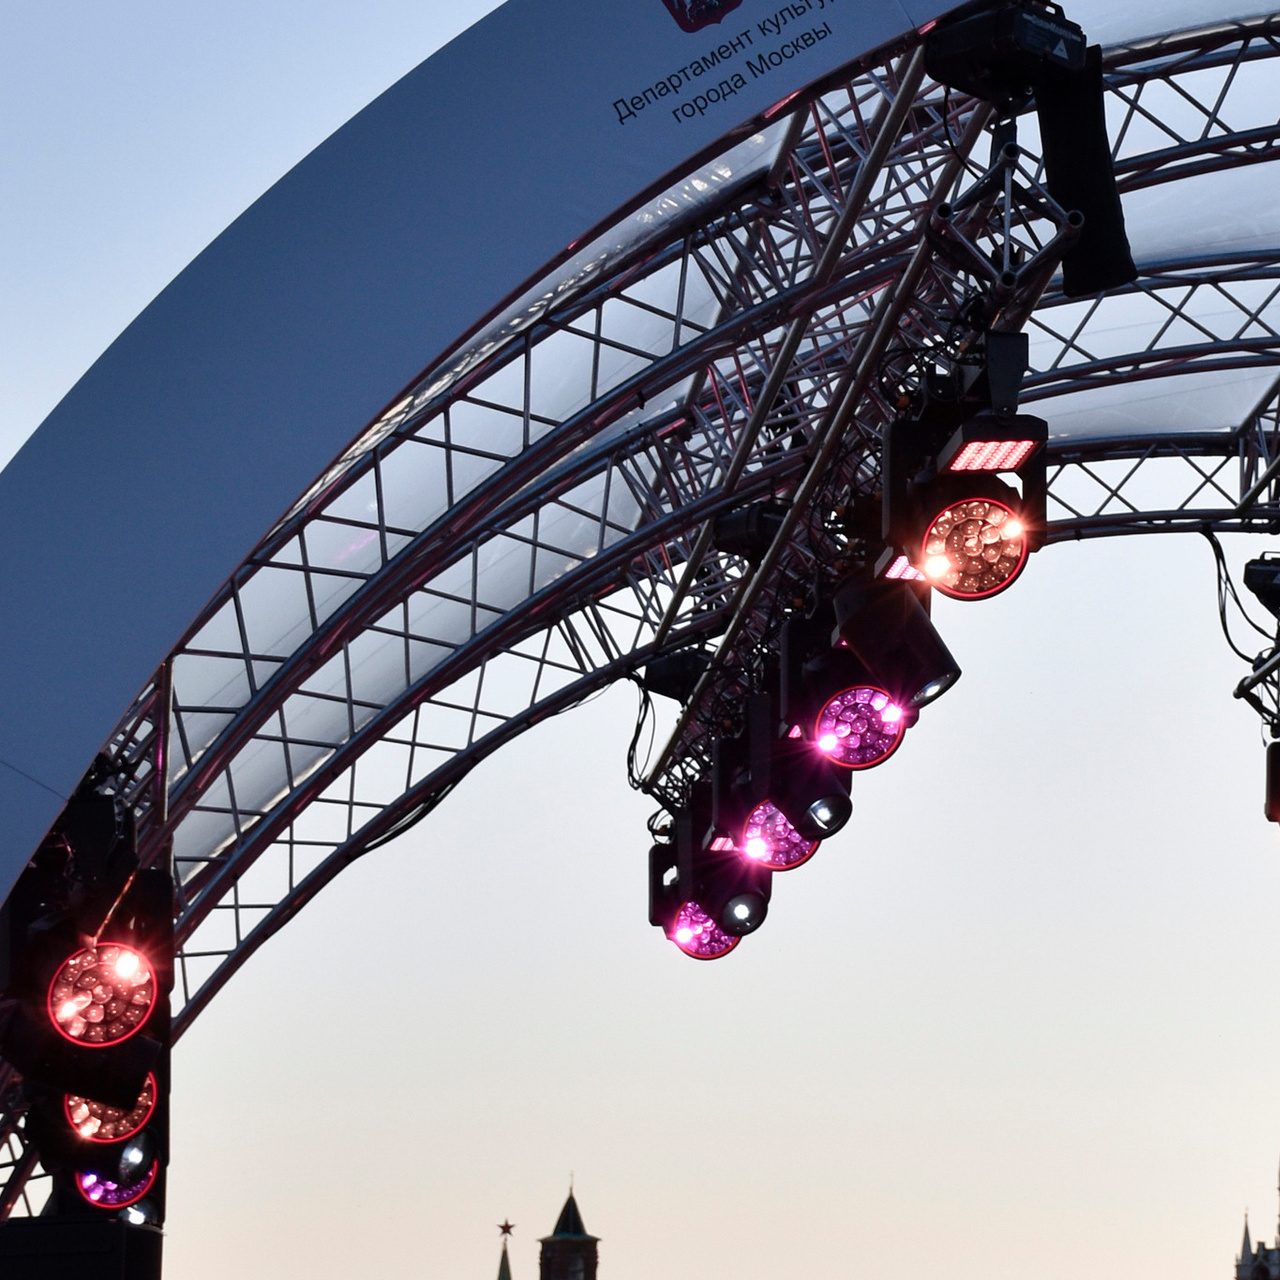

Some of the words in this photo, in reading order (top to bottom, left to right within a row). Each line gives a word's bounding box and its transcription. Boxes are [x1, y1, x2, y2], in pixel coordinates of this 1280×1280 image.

[612, 29, 754, 125] Департамент
[671, 72, 747, 123] города
[746, 22, 833, 79] Москвы
